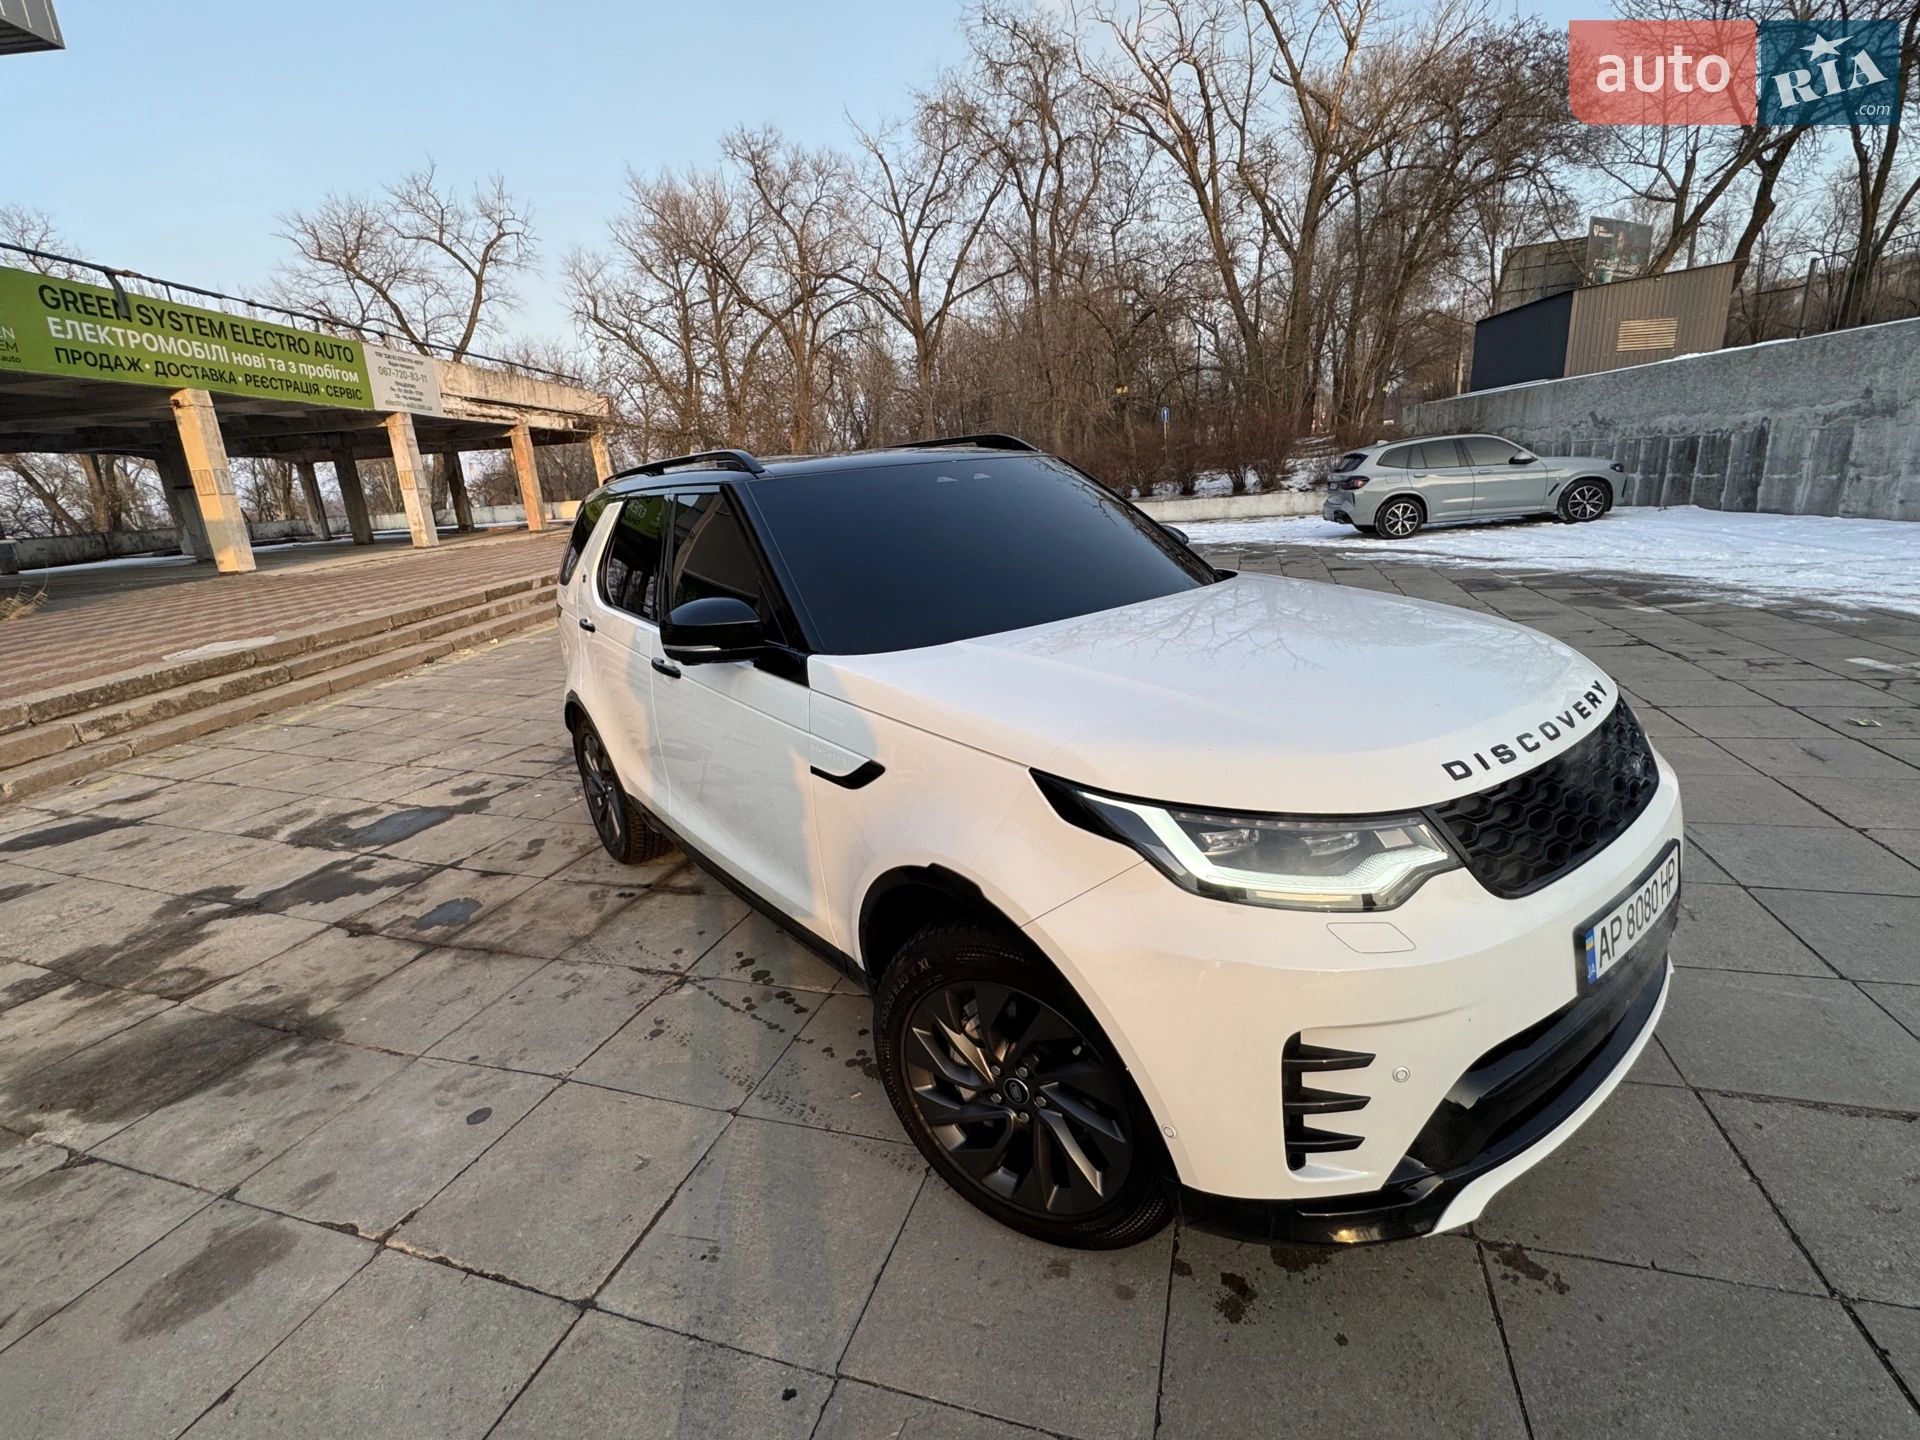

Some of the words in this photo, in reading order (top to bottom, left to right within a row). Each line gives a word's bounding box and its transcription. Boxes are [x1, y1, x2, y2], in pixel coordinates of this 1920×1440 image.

[46, 316, 230, 364] ЕЛЕКТРОМОБІЛІ
[232, 352, 266, 369] нові
[268, 358, 286, 372] та
[299, 362, 359, 384] пробігом
[136, 303, 228, 341] SYSTEM
[230, 322, 310, 356] ELECTRO
[314, 340, 354, 363] AUTO
[54, 346, 145, 373] ПРОДАЖ
[154, 360, 238, 385] ДОСТАВКА
[244, 373, 320, 396] РЕЄСТРАЦІЯ
[325, 384, 363, 401] СЕРВІС
[377, 365, 428, 383] 067-720-83-11
[1441, 679, 1608, 781] DISCOVERY
[1599, 914, 1623, 968] AP
[1626, 878, 1659, 941] 8080
[1660, 857, 1675, 906] HP
